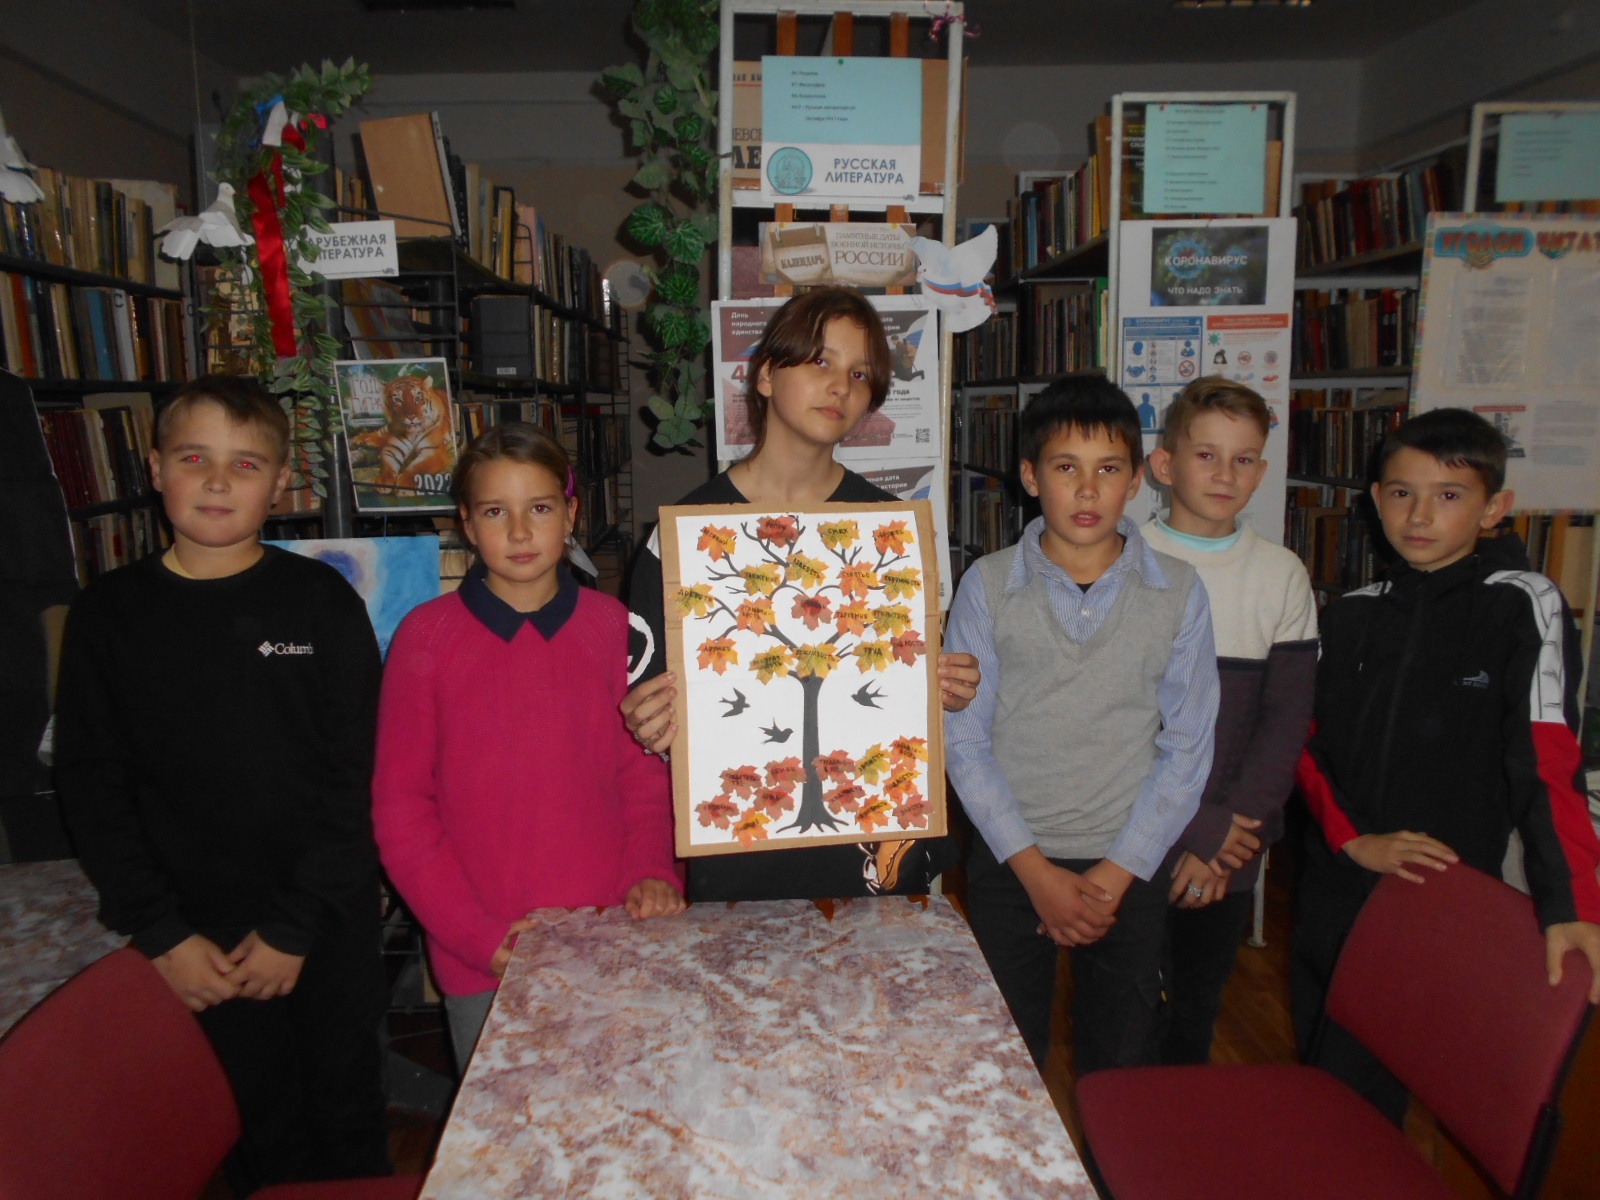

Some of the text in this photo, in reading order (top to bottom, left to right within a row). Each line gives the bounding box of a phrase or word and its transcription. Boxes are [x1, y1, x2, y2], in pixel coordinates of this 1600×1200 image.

[834, 158, 896, 170] РУССКАЯ
[825, 172, 905, 184] ЛИТЕРАТУРА
[308, 233, 387, 248] АРУБЕЖНАЯ
[1441, 230, 1526, 254] УГОЛОК
[319, 246, 385, 260] ТЕРАТУРА
[834, 250, 905, 267] РОССИИ
[780, 254, 825, 268] КАЛЕНДАРЬ
[1165, 254, 1248, 267] КОРОНАВИРУС
[1168, 286, 1243, 295] ЧТО НАДО ЗНАТЬ
[731, 321, 768, 329] народного
[731, 329, 763, 337] единства
[731, 364, 746, 383] 4
[884, 474, 900, 482] дата
